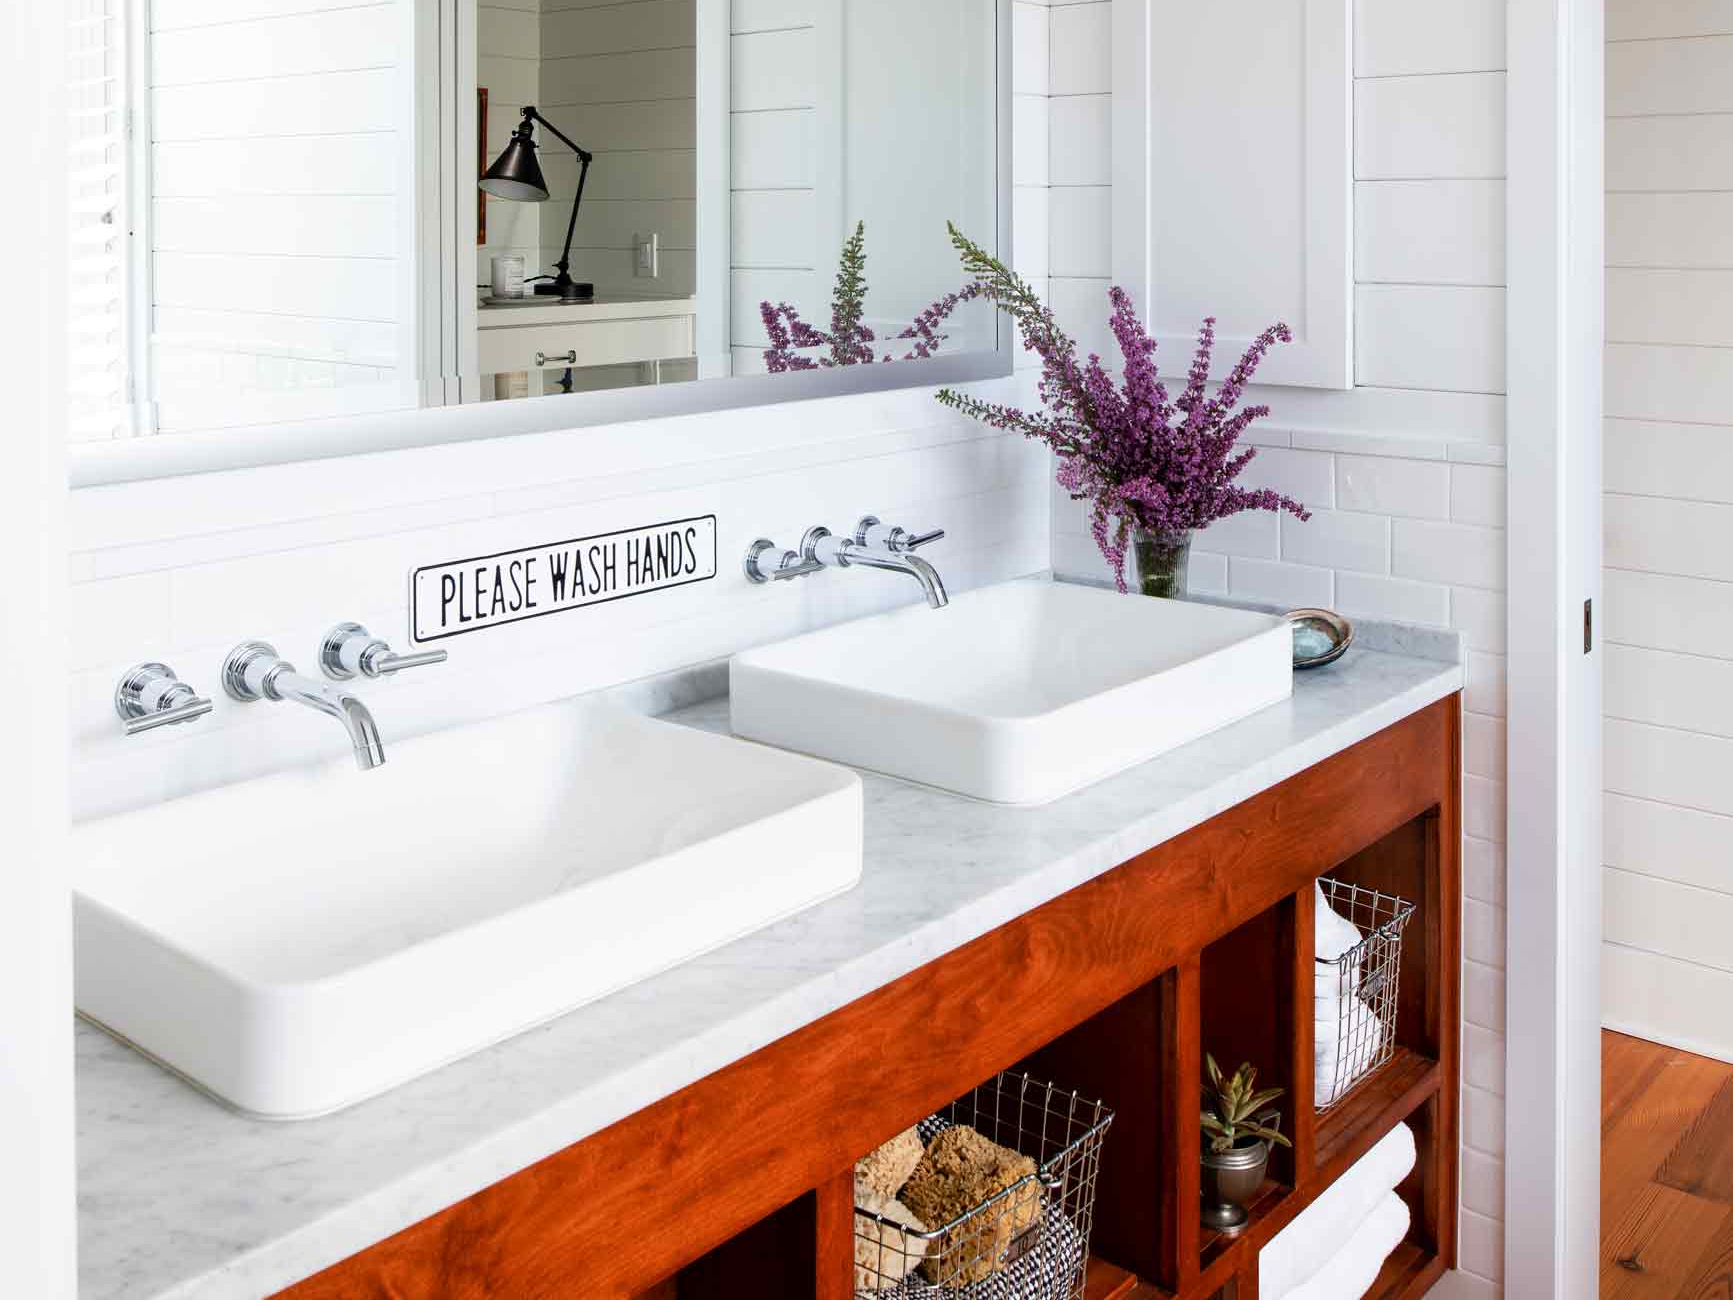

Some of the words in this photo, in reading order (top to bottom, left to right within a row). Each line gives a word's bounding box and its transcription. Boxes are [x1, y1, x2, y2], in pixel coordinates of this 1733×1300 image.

[441, 557, 537, 627] PLEASE
[549, 543, 616, 602] WASH
[627, 527, 697, 588] HANDS
